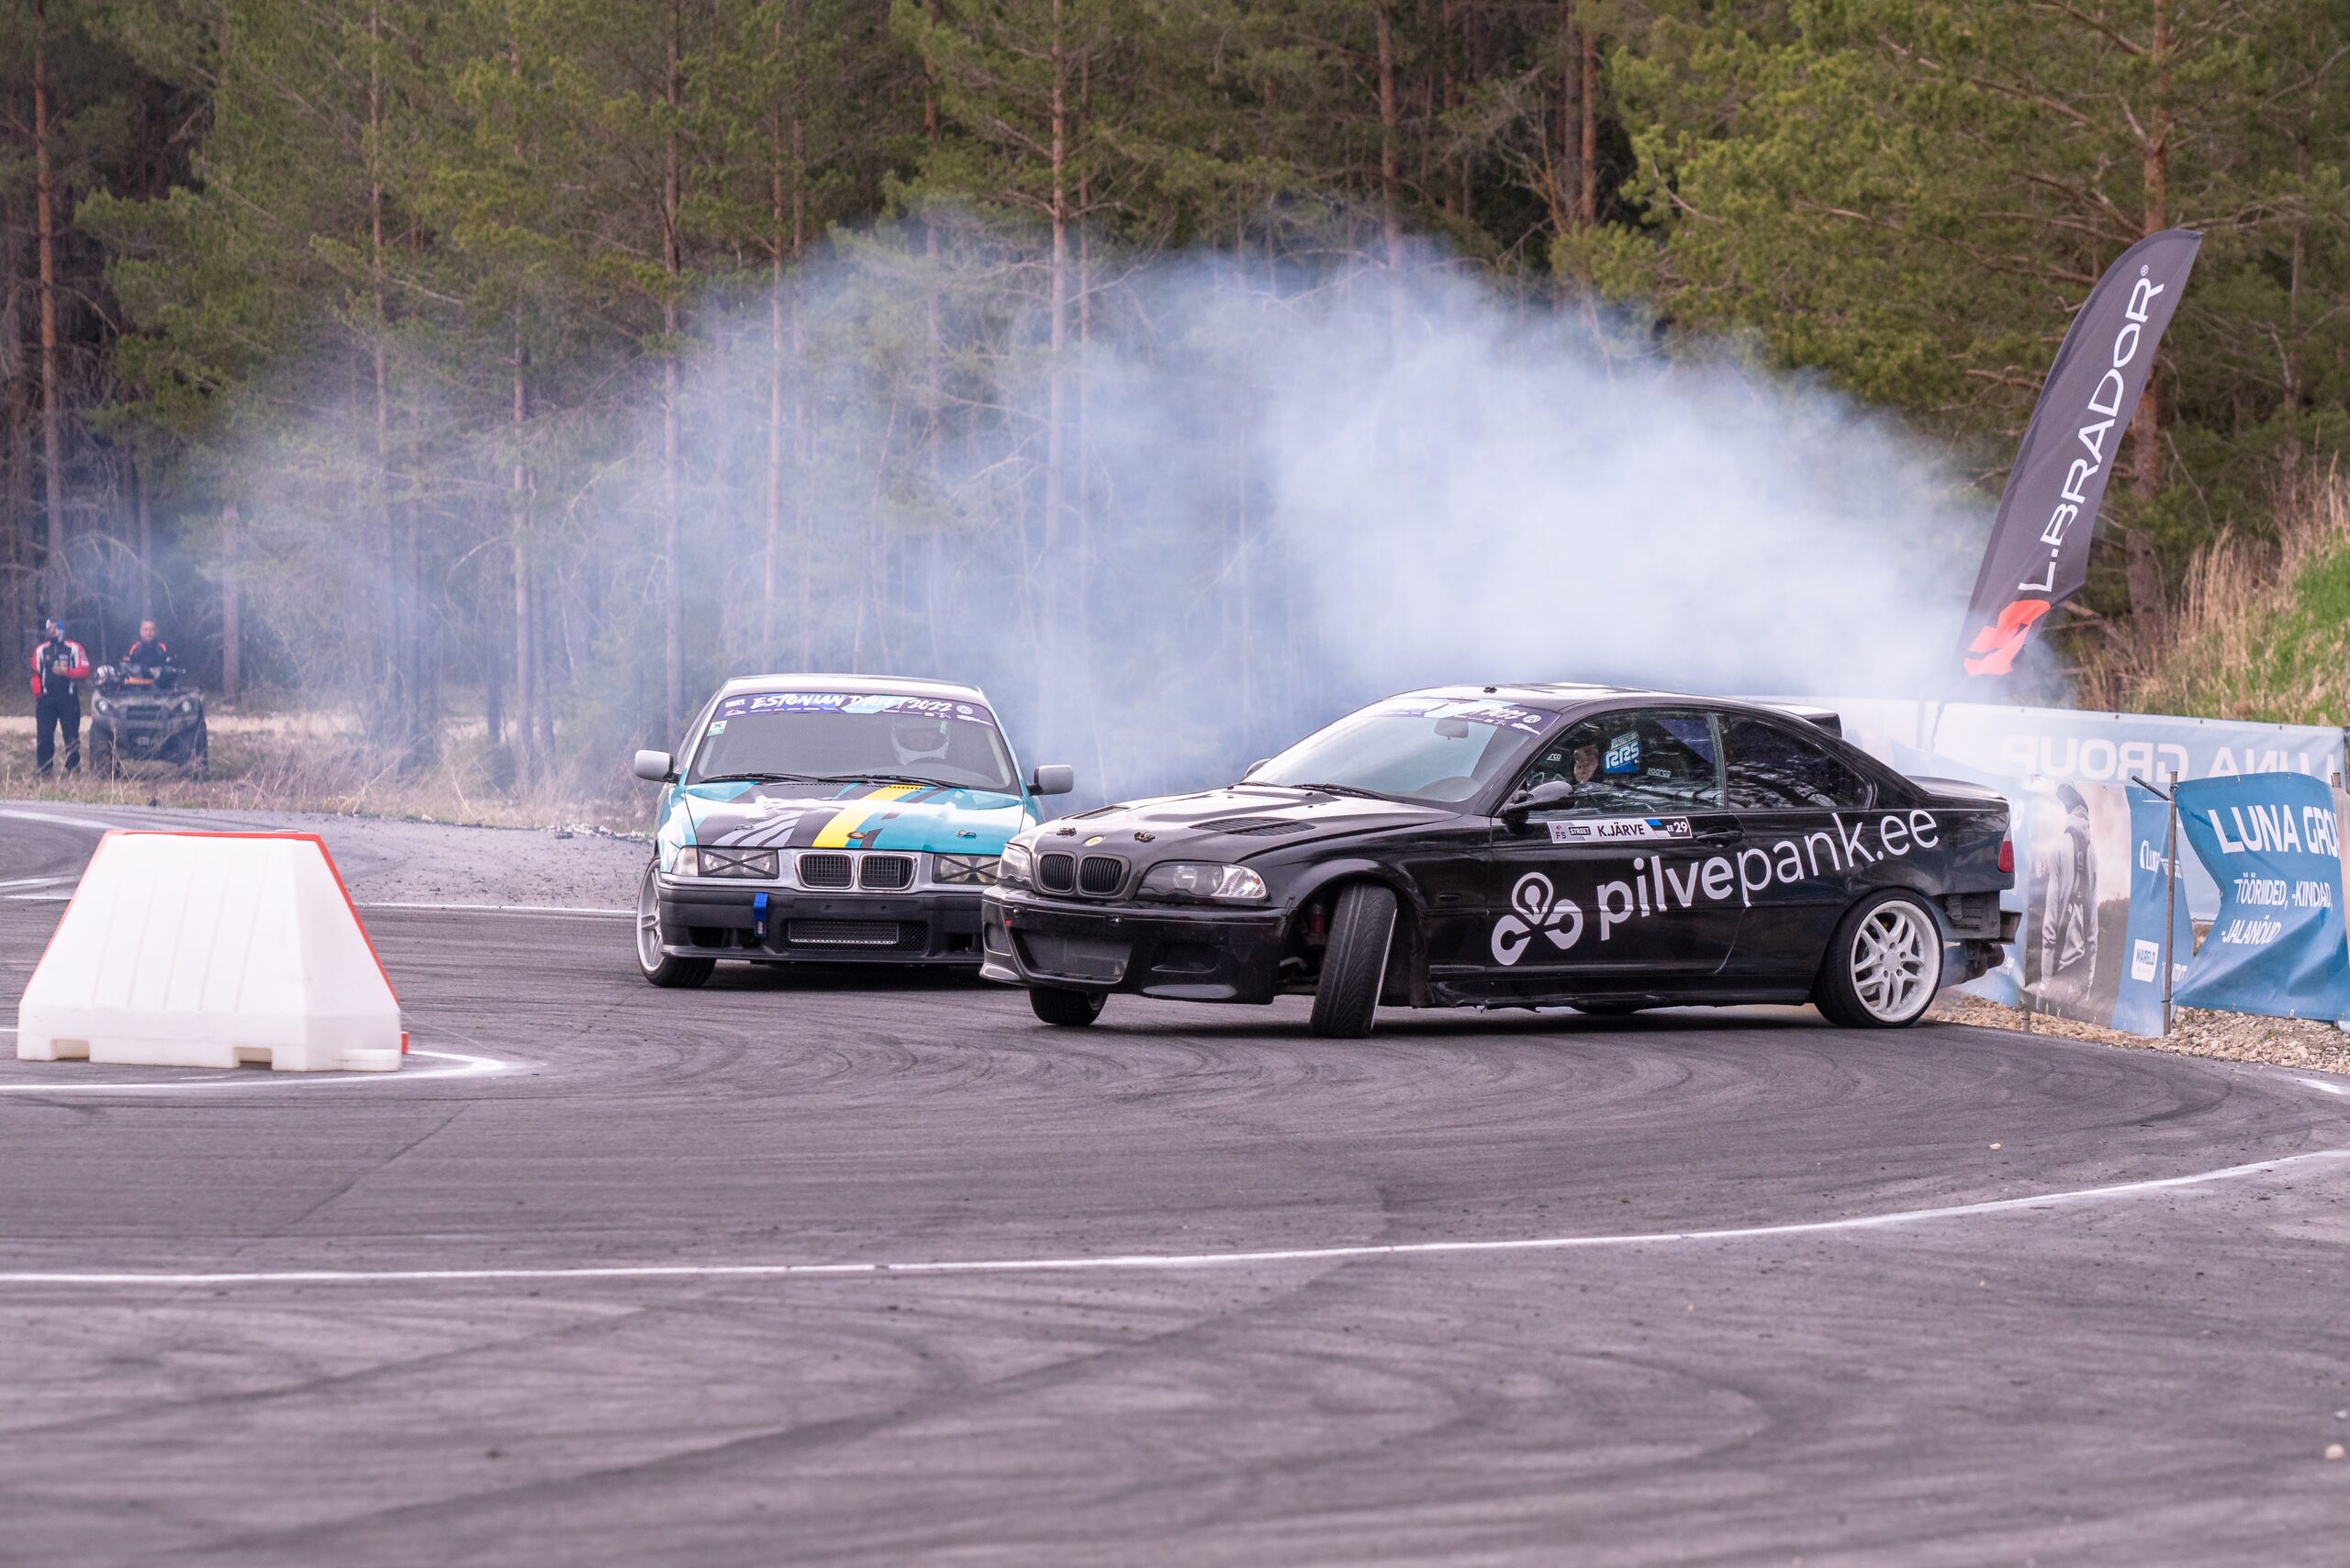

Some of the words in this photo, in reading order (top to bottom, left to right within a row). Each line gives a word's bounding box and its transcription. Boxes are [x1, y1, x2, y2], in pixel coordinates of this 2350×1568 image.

[750, 693, 845, 710] ESTONIAN
[847, 695, 919, 710] DRIFT
[905, 699, 953, 712] 2022
[1606, 741, 1639, 769] RRS
[1646, 767, 1672, 778] sparco
[1555, 831, 1567, 839] FS
[1569, 827, 1592, 836] STREET
[1596, 822, 1646, 837] K.JÄRVE
[1673, 821, 1688, 834] 29
[2208, 804, 2302, 854] LUNA
[1597, 809, 1940, 941] pilvepank.ee
[2232, 871, 2288, 911] TÖÖRIIDED,
